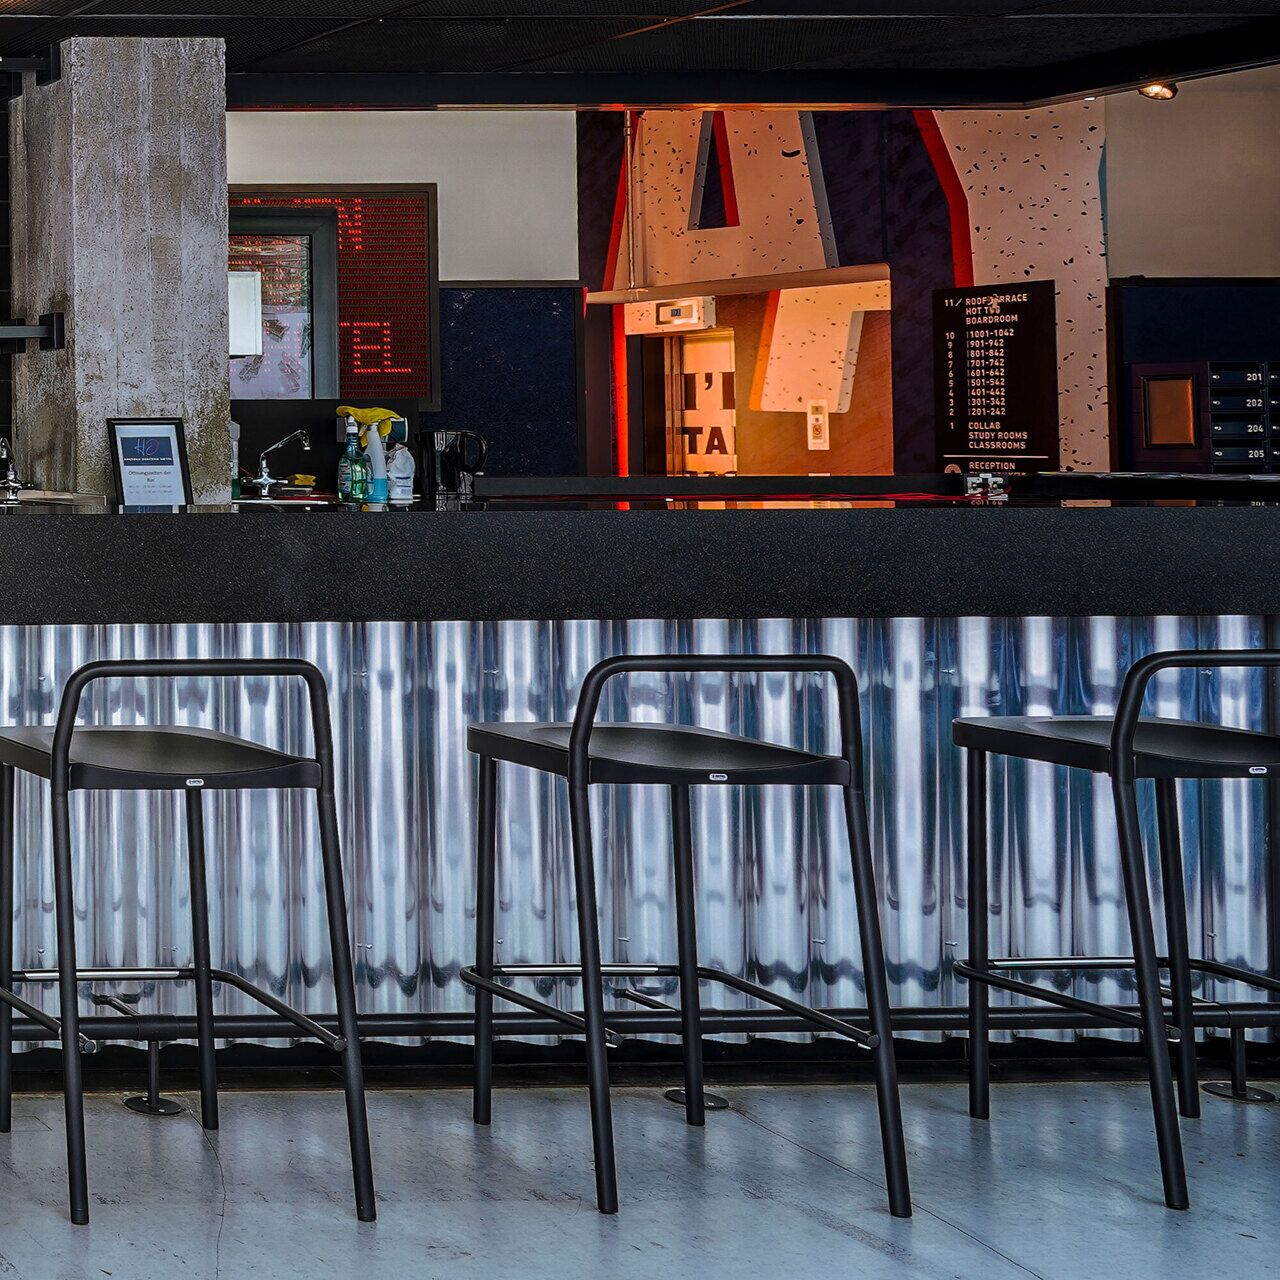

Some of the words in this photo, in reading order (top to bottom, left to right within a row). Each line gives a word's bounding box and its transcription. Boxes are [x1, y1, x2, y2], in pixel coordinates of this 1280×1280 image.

[965, 298, 987, 306] ROOF
[966, 307, 982, 315] HOT
[966, 314, 1018, 325] BOARDROOM
[1246, 373, 1262, 381] 201
[1246, 399, 1263, 407] 202
[968, 422, 1001, 430] COLLAB
[1247, 425, 1264, 433] 204
[968, 431, 996, 440] STUDY
[997, 431, 1028, 440] ROOMS
[968, 441, 1026, 449] CLASSROOMS
[1248, 450, 1265, 458] 205
[969, 462, 1016, 470] RECEPTION
